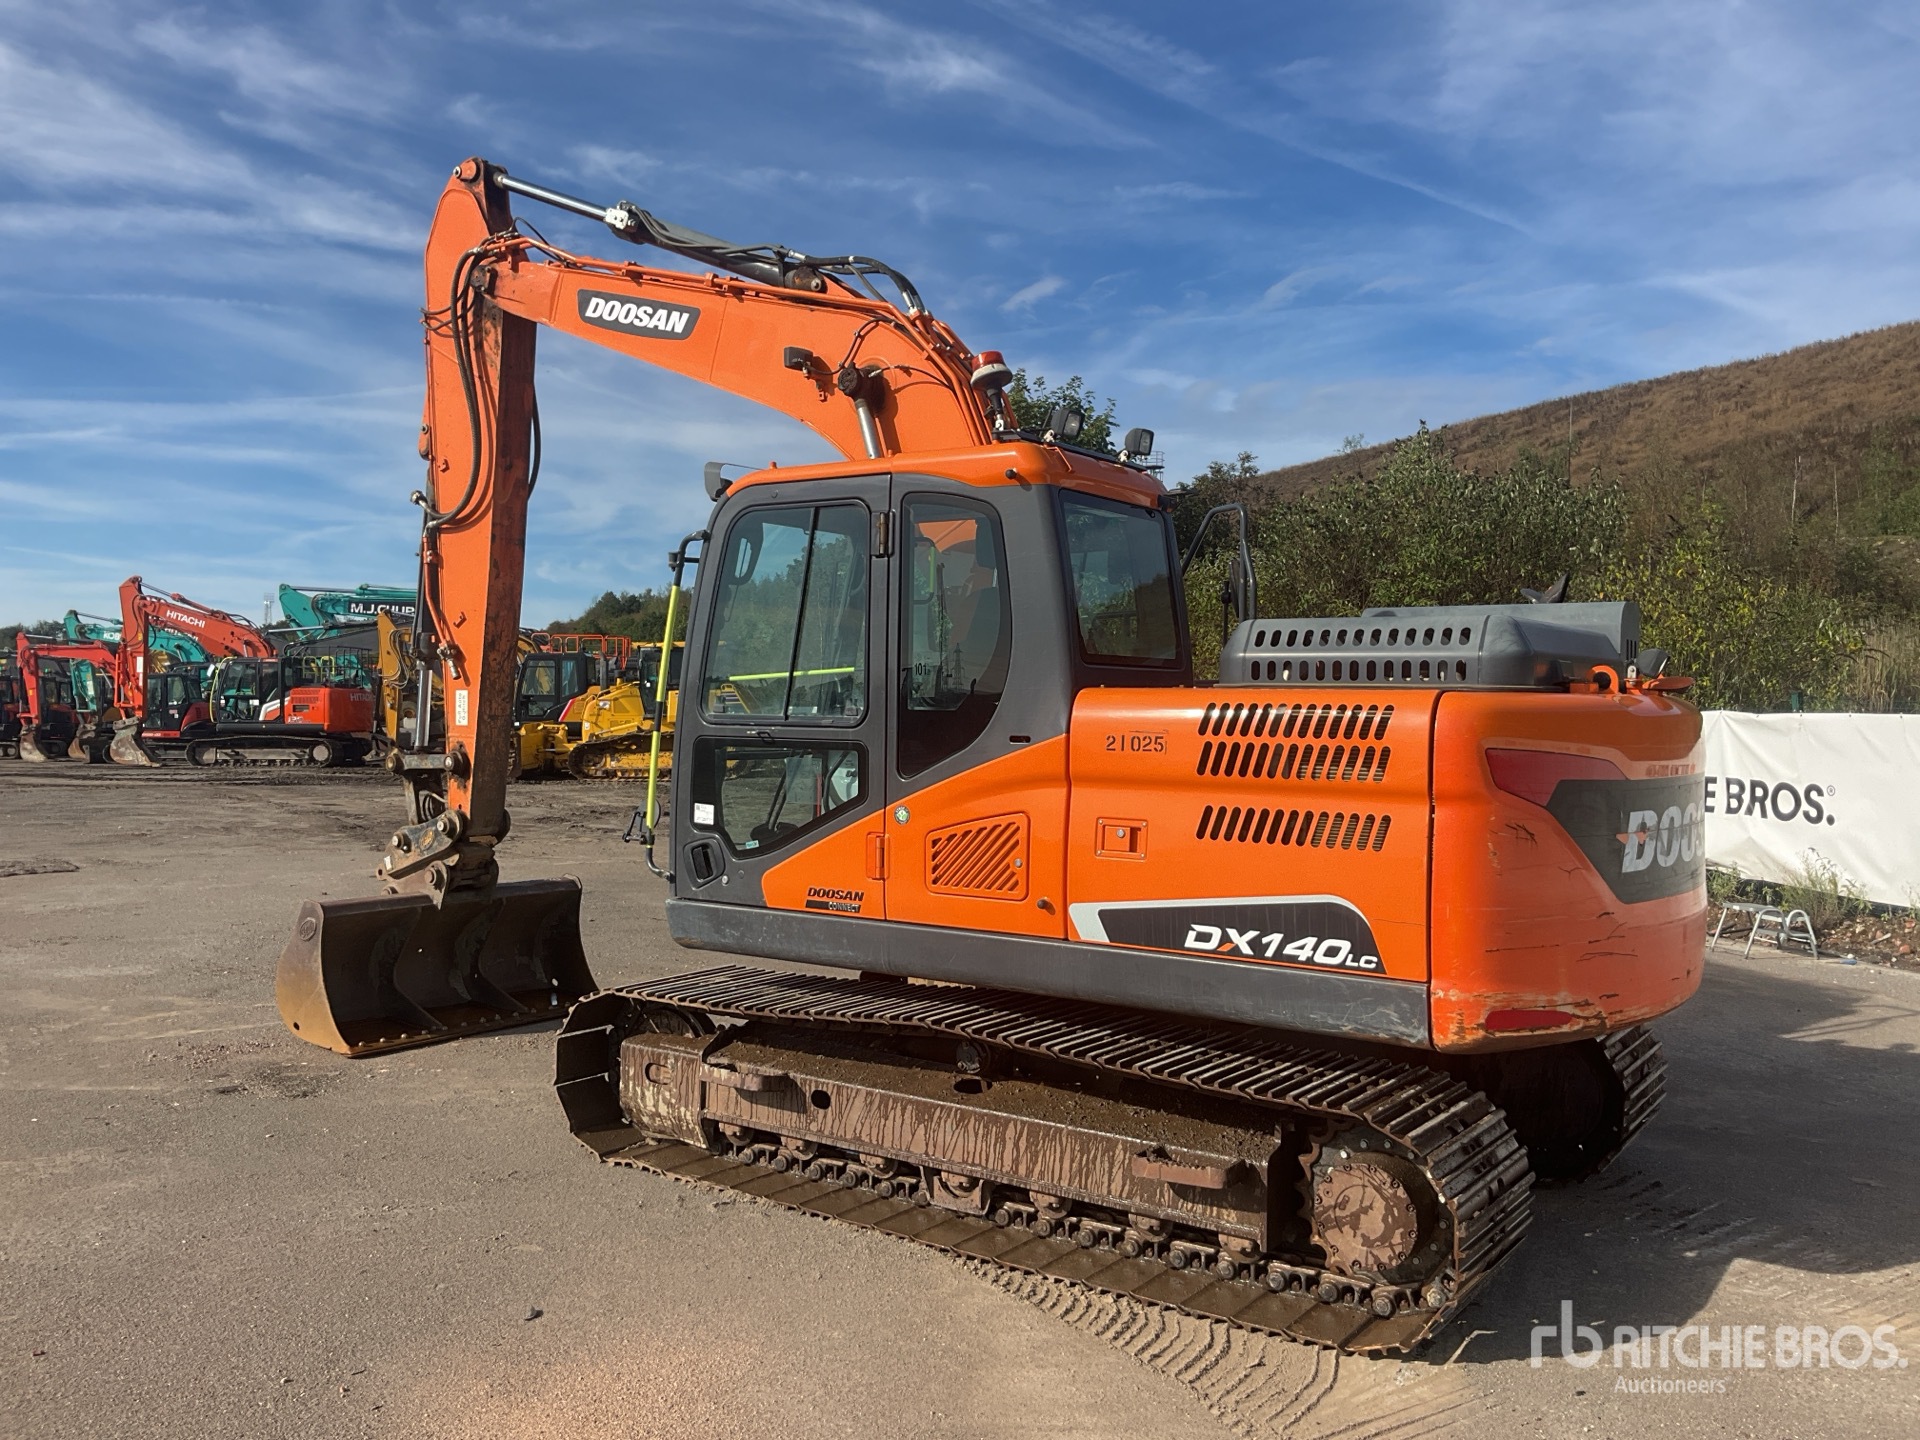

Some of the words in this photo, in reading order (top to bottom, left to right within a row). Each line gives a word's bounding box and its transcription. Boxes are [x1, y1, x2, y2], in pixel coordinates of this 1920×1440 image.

[585, 297, 690, 333] DOOSAN
[166, 609, 205, 628] HITACHI
[1106, 734, 1164, 752] 21025
[808, 887, 865, 901] DOOSAN
[828, 901, 860, 912] CONNECT
